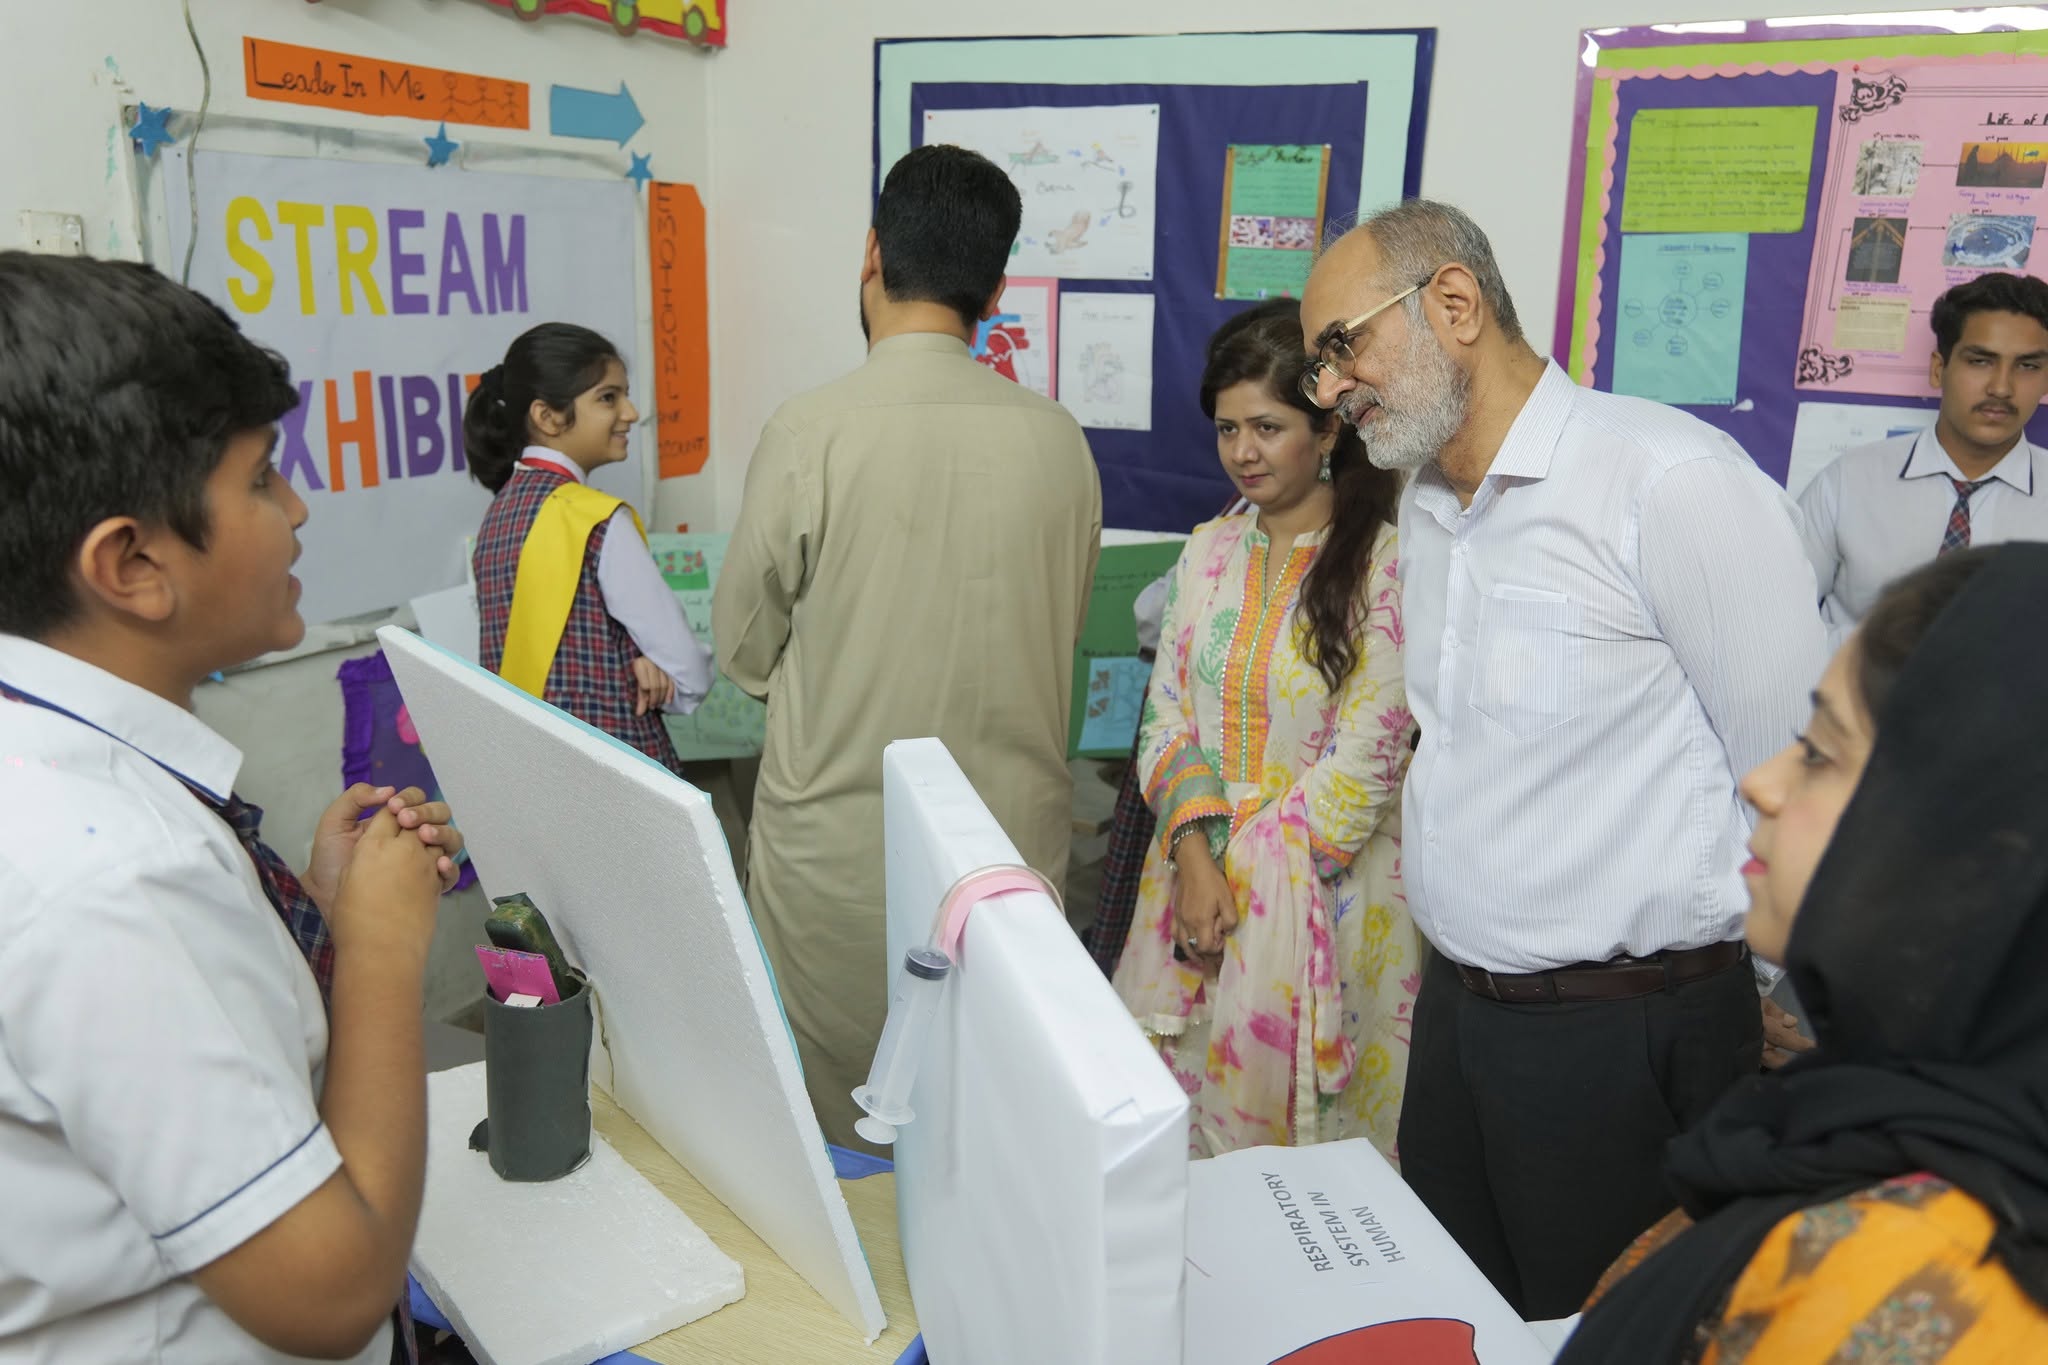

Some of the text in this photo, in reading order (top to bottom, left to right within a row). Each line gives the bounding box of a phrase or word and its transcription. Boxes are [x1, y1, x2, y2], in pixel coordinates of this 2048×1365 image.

[251, 40, 426, 101] Leader In Me
[225, 196, 528, 316] STREAM
[278, 370, 482, 493] XHIBI
[1261, 1172, 1334, 1272] RESPIRATORY
[1307, 1191, 1370, 1267] SYSTEM IN
[1351, 1206, 1405, 1263] HUMAN
